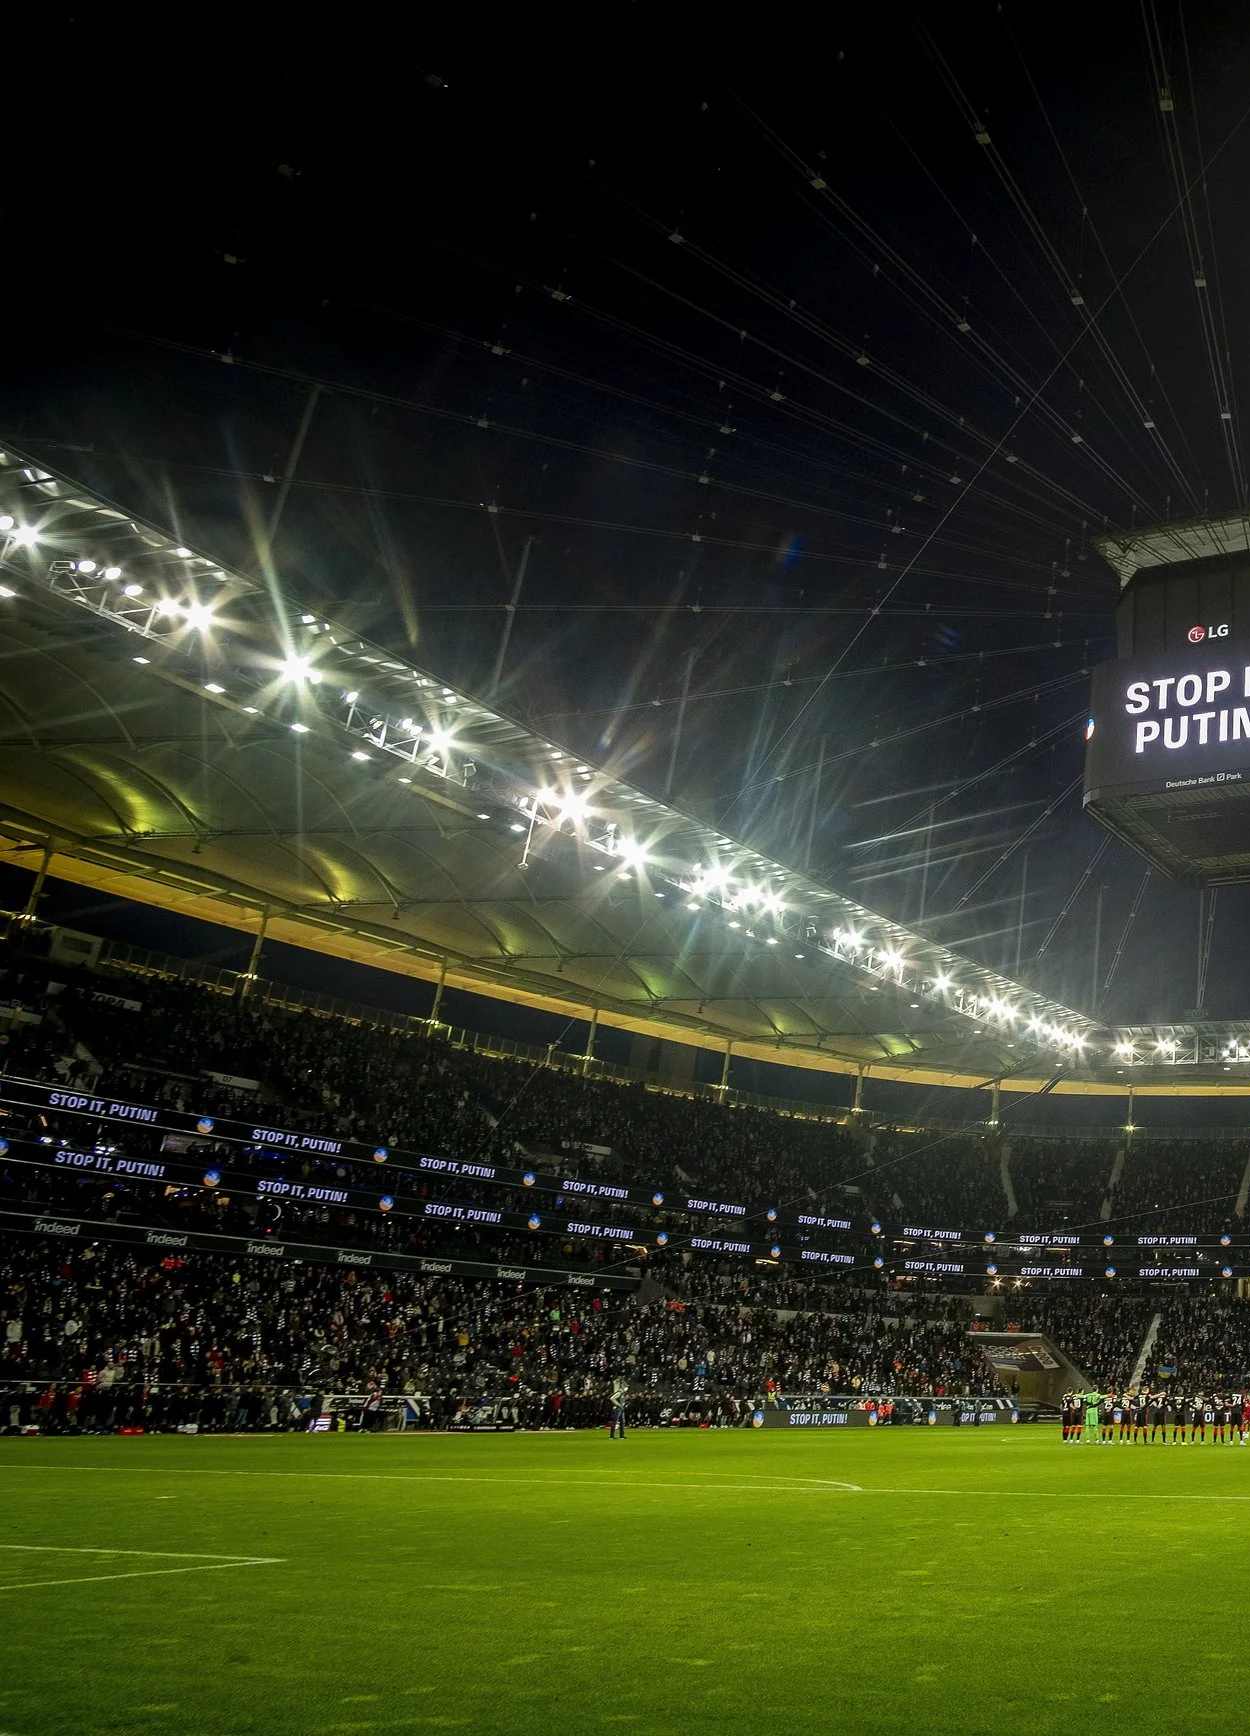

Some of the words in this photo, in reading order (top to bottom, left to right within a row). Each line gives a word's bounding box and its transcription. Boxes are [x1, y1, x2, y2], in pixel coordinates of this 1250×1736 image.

[1208, 624, 1228, 638] LG
[1126, 670, 1230, 714] STOP
[1166, 776, 1197, 788] Deutsche
[1199, 776, 1215, 784] Bank
[1226, 772, 1242, 780] Park
[49, 1093, 88, 1108] STOP
[89, 1100, 106, 1115] IT,
[109, 1104, 157, 1122] PUTIN!
[252, 1129, 284, 1143] STOP
[285, 1135, 299, 1148] IT,
[301, 1138, 341, 1153] PUTIN!
[55, 1151, 94, 1166] STOP
[96, 1157, 112, 1171] IT,
[116, 1160, 165, 1176] PUTIN!
[420, 1158, 447, 1170] STOP
[447, 1162, 459, 1173] IT,
[461, 1164, 495, 1178] PUTIN!
[258, 1180, 290, 1194] STOP
[291, 1185, 305, 1198] IT,
[307, 1188, 348, 1202] PUTIN!
[563, 1180, 586, 1192] STOP
[587, 1184, 597, 1195] IT,
[598, 1186, 628, 1198] PUTIN!
[425, 1204, 452, 1216] STOP
[453, 1208, 465, 1219] IT,
[467, 1210, 501, 1222] PUTIN!
[688, 1200, 708, 1209] STOP
[708, 1202, 718, 1212] IT,
[719, 1204, 746, 1215] PUTIN!
[33, 1218, 81, 1236] indeed
[567, 1223, 591, 1234] STOP
[591, 1226, 602, 1237] IT,
[603, 1228, 633, 1239] PUTIN!
[904, 1228, 923, 1236] STOP
[924, 1230, 933, 1238] IT,
[934, 1230, 961, 1239] PUTIN!
[146, 1231, 188, 1247] indeed
[691, 1238, 712, 1248] STOP
[712, 1241, 722, 1250] IT,
[723, 1242, 750, 1252] PUTIN!
[1159, 1237, 1169, 1245] IT,
[247, 1241, 284, 1256] indeed
[338, 1250, 371, 1265] indeed
[420, 1260, 452, 1273] indeed
[497, 1265, 526, 1280] indeed
[1043, 1268, 1053, 1276] IT,
[1054, 1268, 1082, 1276] PUTIN!
[568, 1273, 594, 1286] indeed
[790, 1414, 810, 1424] STOP
[811, 1414, 820, 1426] IT,
[822, 1414, 848, 1424] PUTIN!
